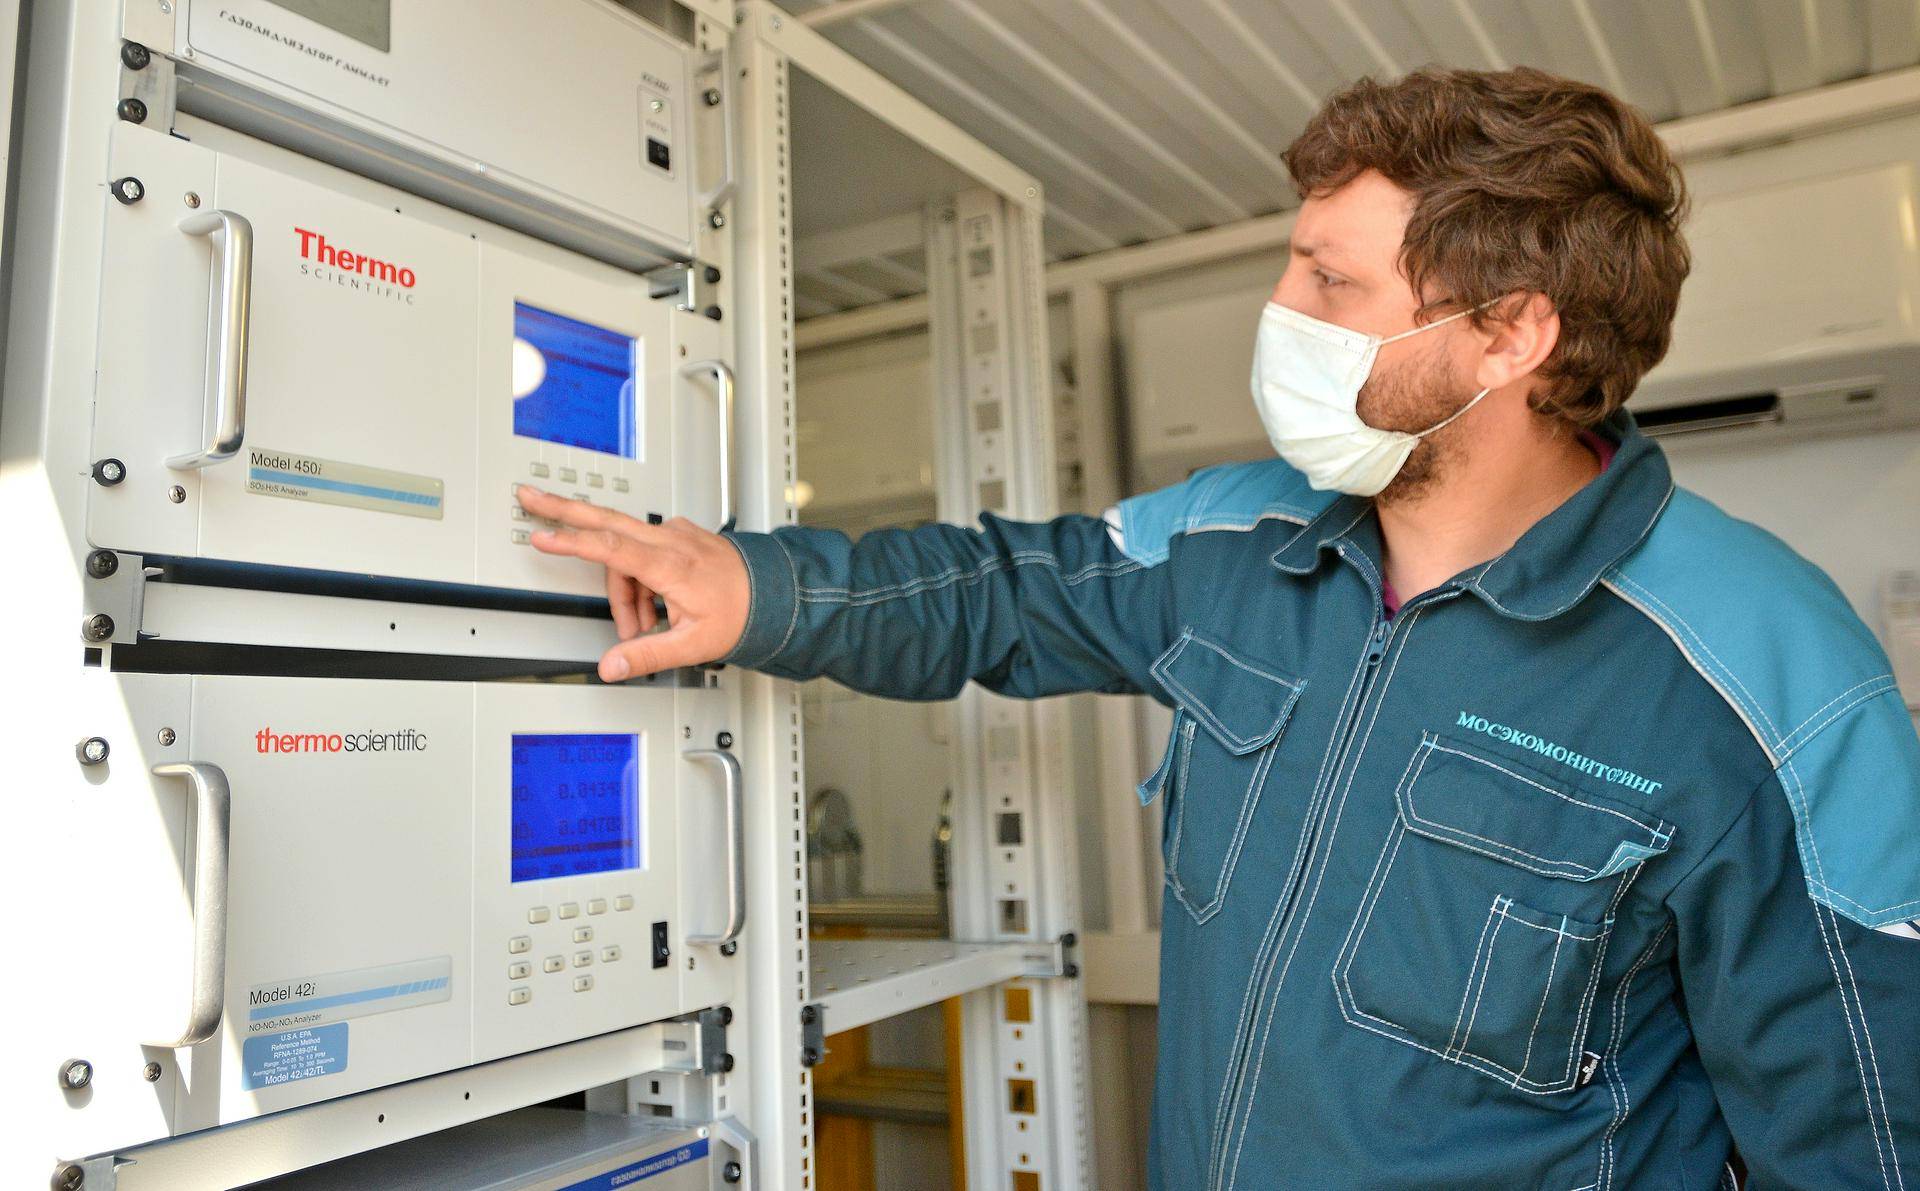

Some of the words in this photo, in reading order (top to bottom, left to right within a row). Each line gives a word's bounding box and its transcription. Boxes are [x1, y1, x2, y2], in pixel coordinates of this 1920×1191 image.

[294, 227, 416, 288] Thermo
[300, 264, 413, 305] SCIENTIFIC
[251, 452, 290, 470] Model
[295, 460, 322, 475] 450i
[256, 727, 342, 753] thermo
[344, 729, 427, 752] scientific
[1456, 711, 1663, 795] МОСЭКОМОНИТОРИНГ
[250, 986, 290, 1005] Model
[295, 982, 316, 997] 42i
[294, 1013, 322, 1024] Analyzer
[271, 1040, 299, 1051] Reference
[300, 1037, 321, 1046] Method
[300, 1030, 312, 1038] EPA
[265, 1072, 289, 1085] Model
